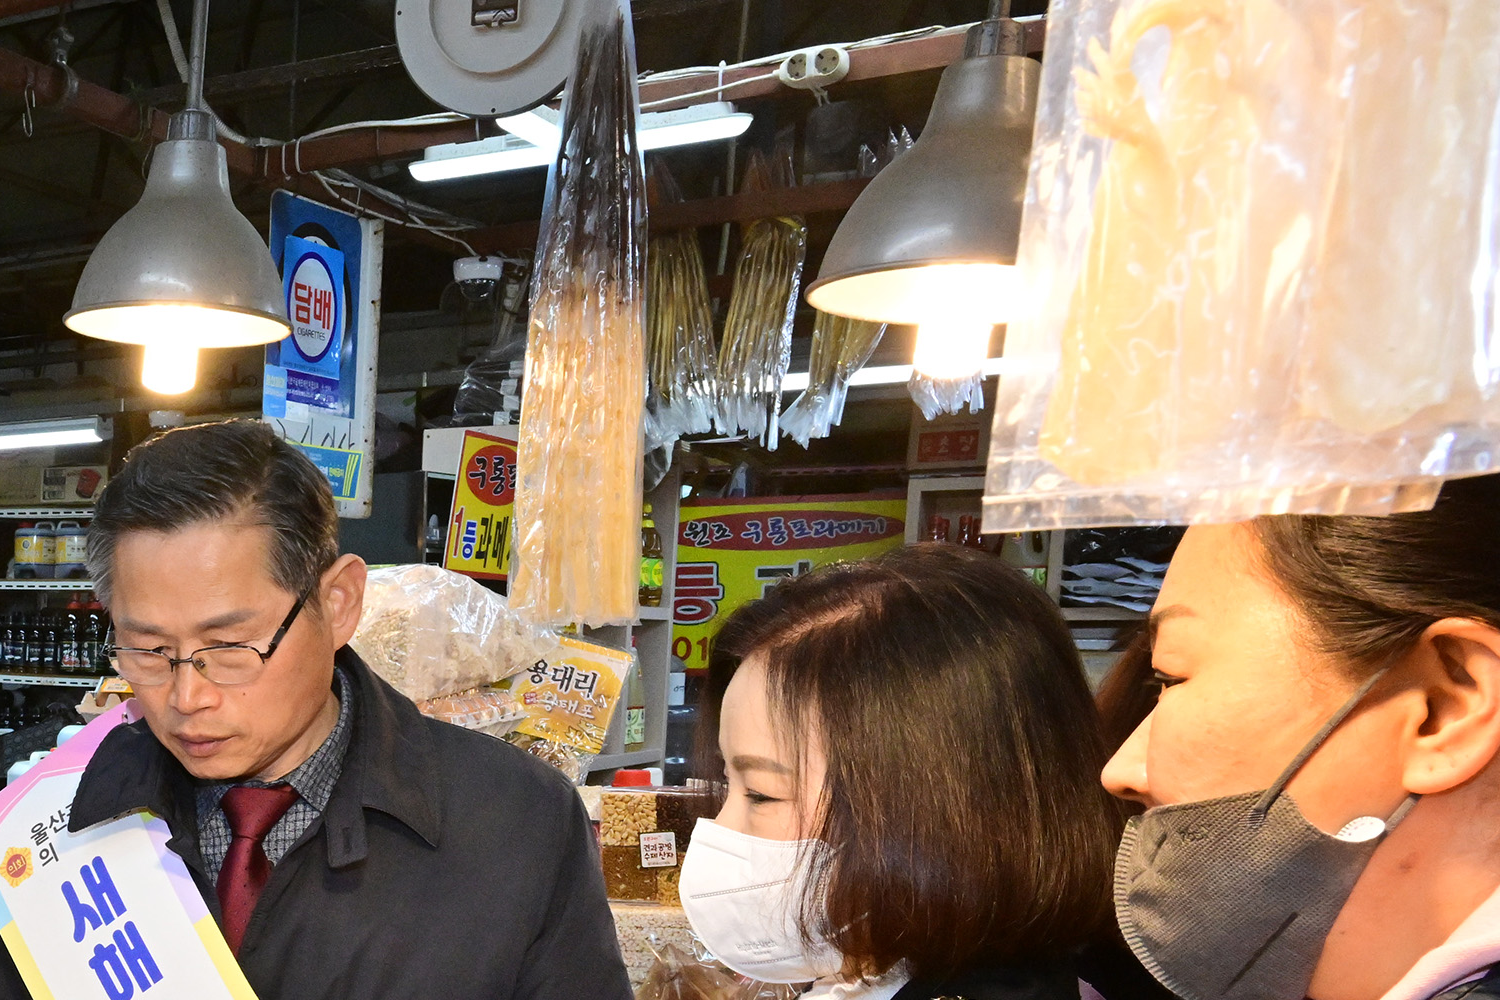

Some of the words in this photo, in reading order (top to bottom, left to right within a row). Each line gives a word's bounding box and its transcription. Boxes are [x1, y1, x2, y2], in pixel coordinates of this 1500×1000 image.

[294, 282, 332, 330] 담배
[297, 326, 326, 341] CIGARETTES
[475, 513, 511, 569] 과메
[683, 521, 733, 548] 원조
[741, 516, 887, 546] 구룡포과메기
[527, 658, 600, 700] 용대리
[30, 803, 74, 846] 울산
